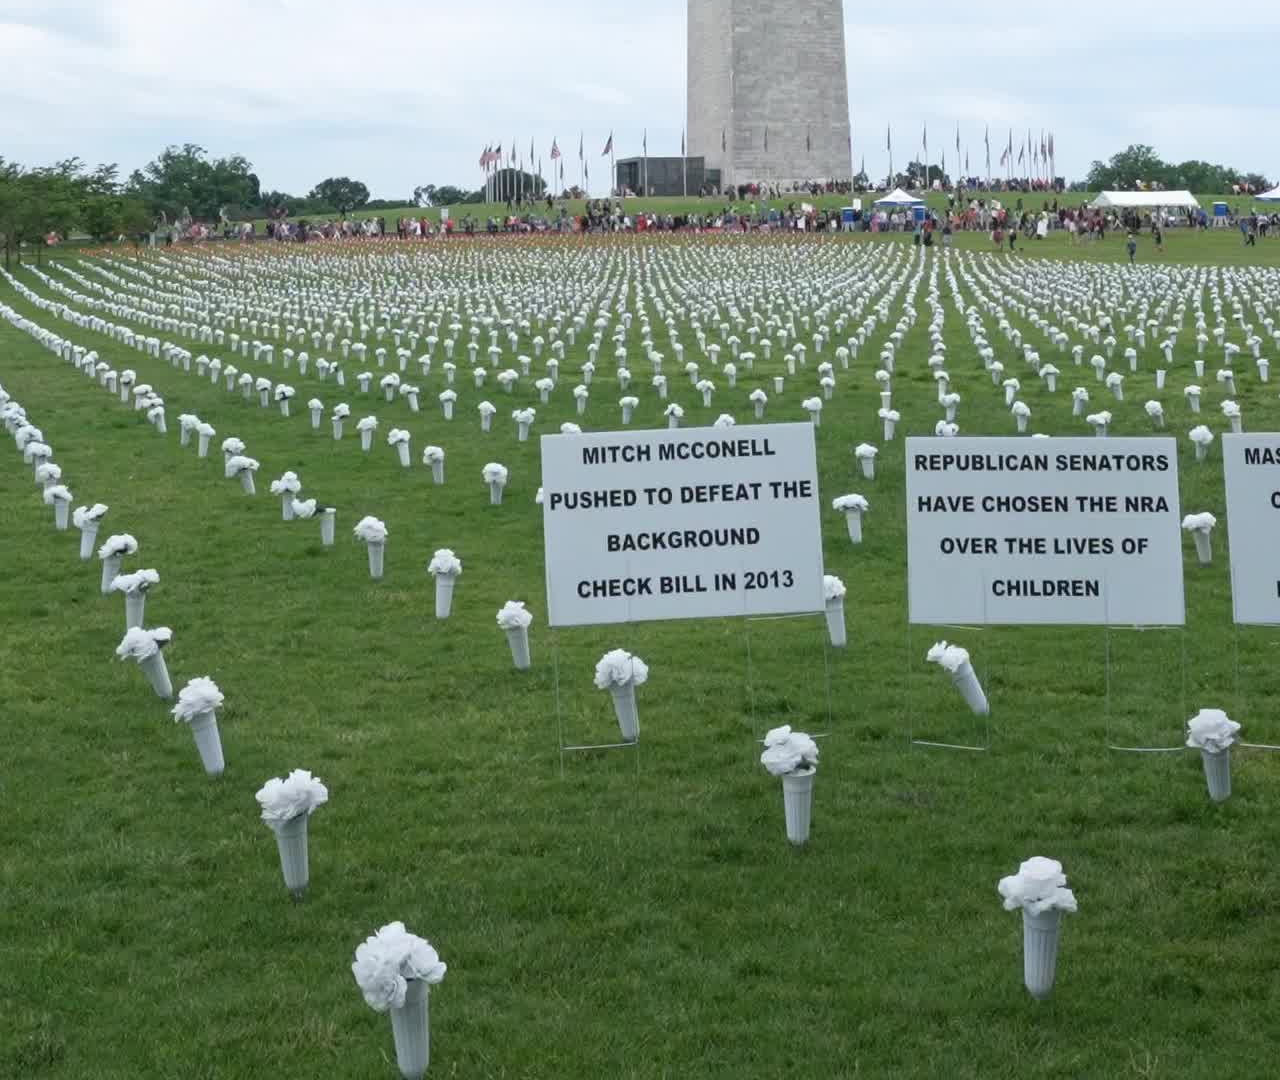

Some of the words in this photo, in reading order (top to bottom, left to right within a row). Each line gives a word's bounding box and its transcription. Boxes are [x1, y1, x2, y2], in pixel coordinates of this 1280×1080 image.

[583, 445, 650, 464] MITCH
[659, 439, 775, 460] MCCONELL
[915, 455, 1047, 470] REPUBLICAN
[1056, 455, 1168, 471] SENATORS
[551, 490, 636, 510] PUSHED
[644, 488, 672, 504] TO
[681, 483, 761, 503] DEFEAT
[769, 481, 811, 498] THE
[918, 496, 974, 512] HAVE
[982, 496, 1068, 512] CHOSEN
[1076, 497, 1117, 512] THE
[1126, 497, 1168, 512] NRA
[608, 528, 759, 551] BACKGROUND
[941, 538, 997, 554] OVER
[1005, 538, 1046, 554] THE
[1054, 538, 1113, 554] LIVES
[1122, 538, 1148, 554] OF
[578, 578, 652, 598] CHECK
[660, 576, 707, 593] BILL
[715, 574, 736, 590] IN
[744, 570, 793, 589] 2013
[992, 580, 1099, 596] CHILDREN
